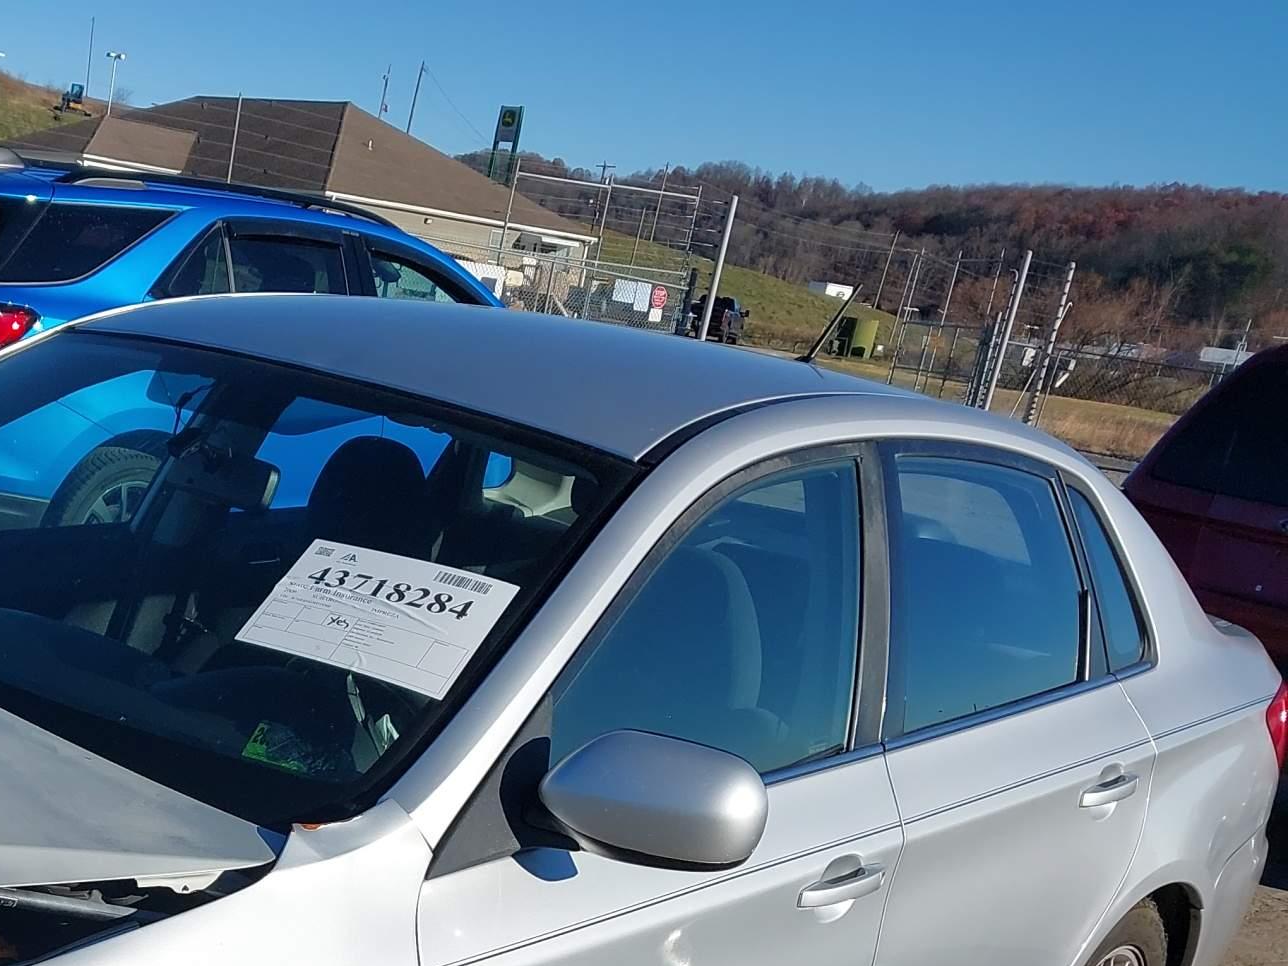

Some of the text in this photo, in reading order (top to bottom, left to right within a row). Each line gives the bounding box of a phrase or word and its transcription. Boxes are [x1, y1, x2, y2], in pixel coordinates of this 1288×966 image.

[307, 566, 476, 620] 43718284
[310, 586, 332, 595] Farm
[332, 589, 372, 605] Insurance
